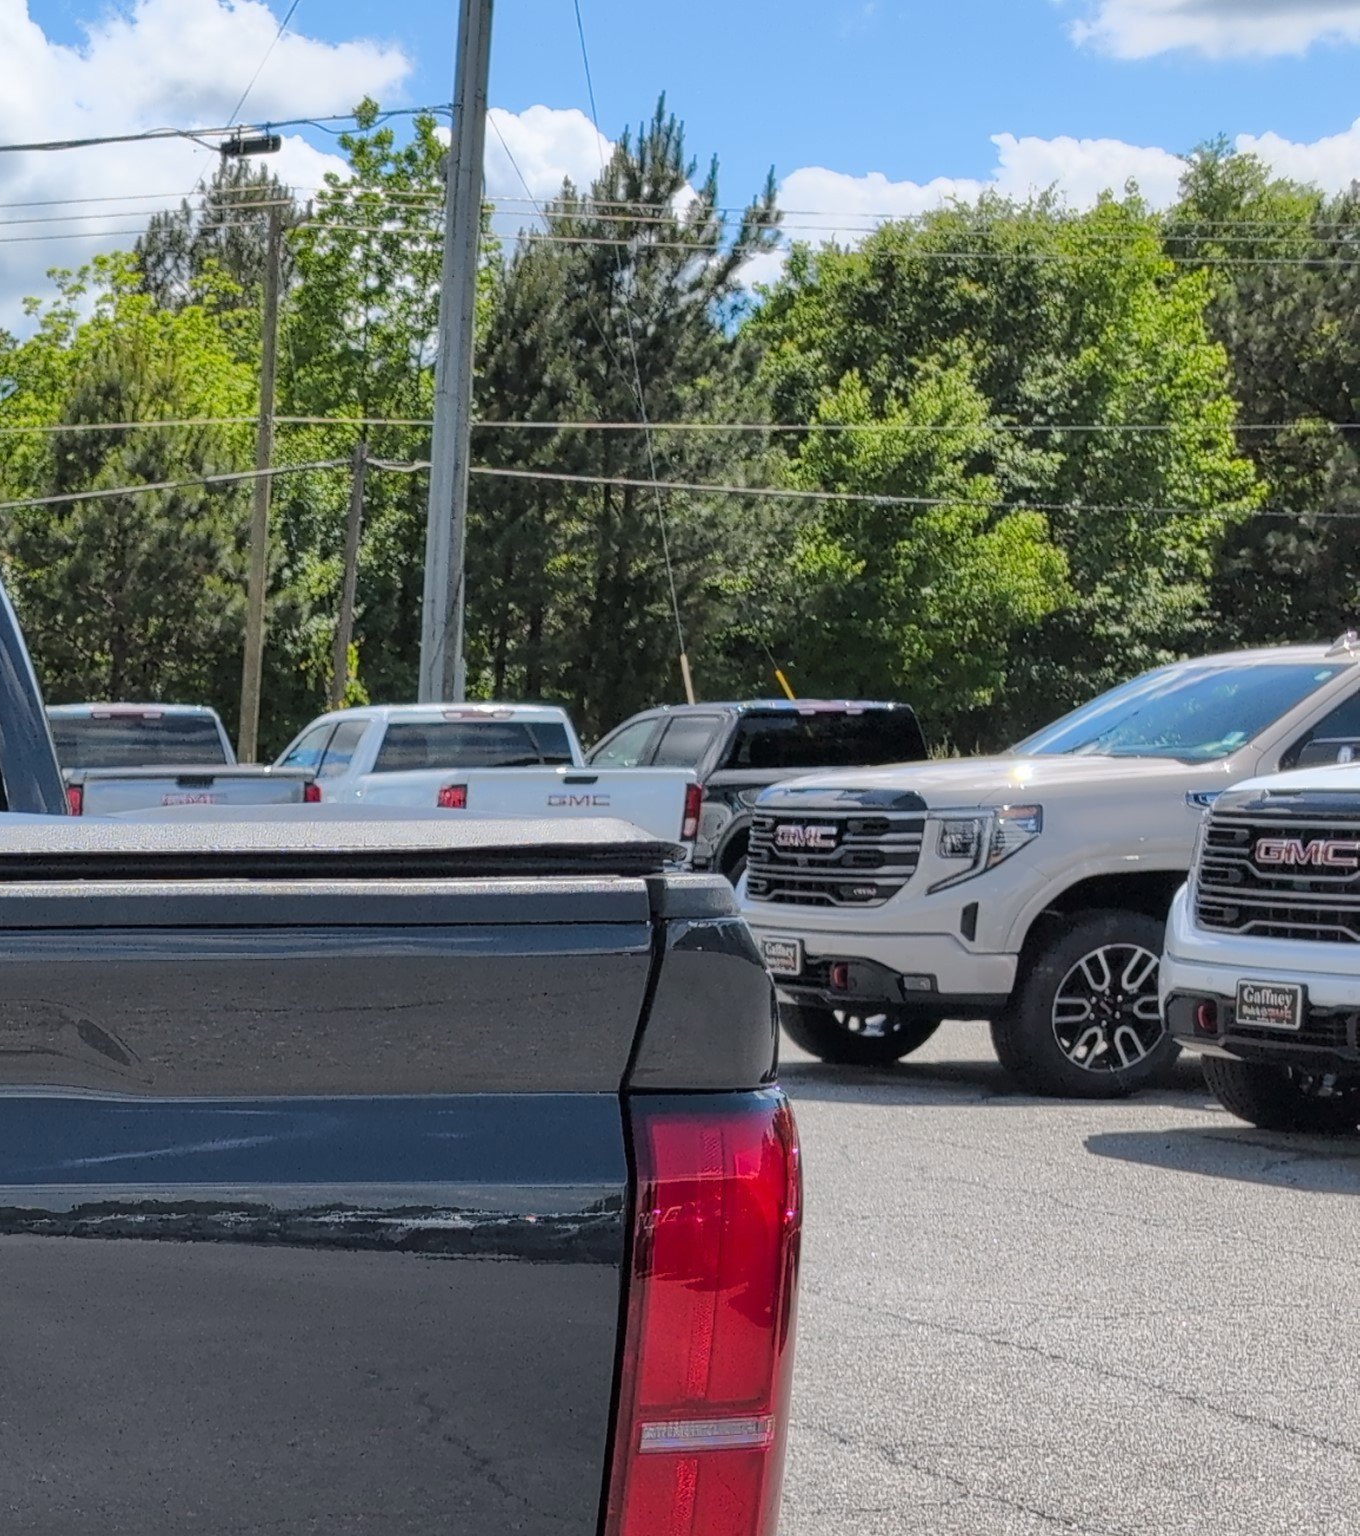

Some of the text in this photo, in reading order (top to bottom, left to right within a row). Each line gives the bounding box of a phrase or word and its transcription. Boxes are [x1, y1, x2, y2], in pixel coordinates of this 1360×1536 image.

[547, 794, 611, 807] GMC
[775, 824, 838, 848] GMC
[1255, 838, 1359, 868] GMC
